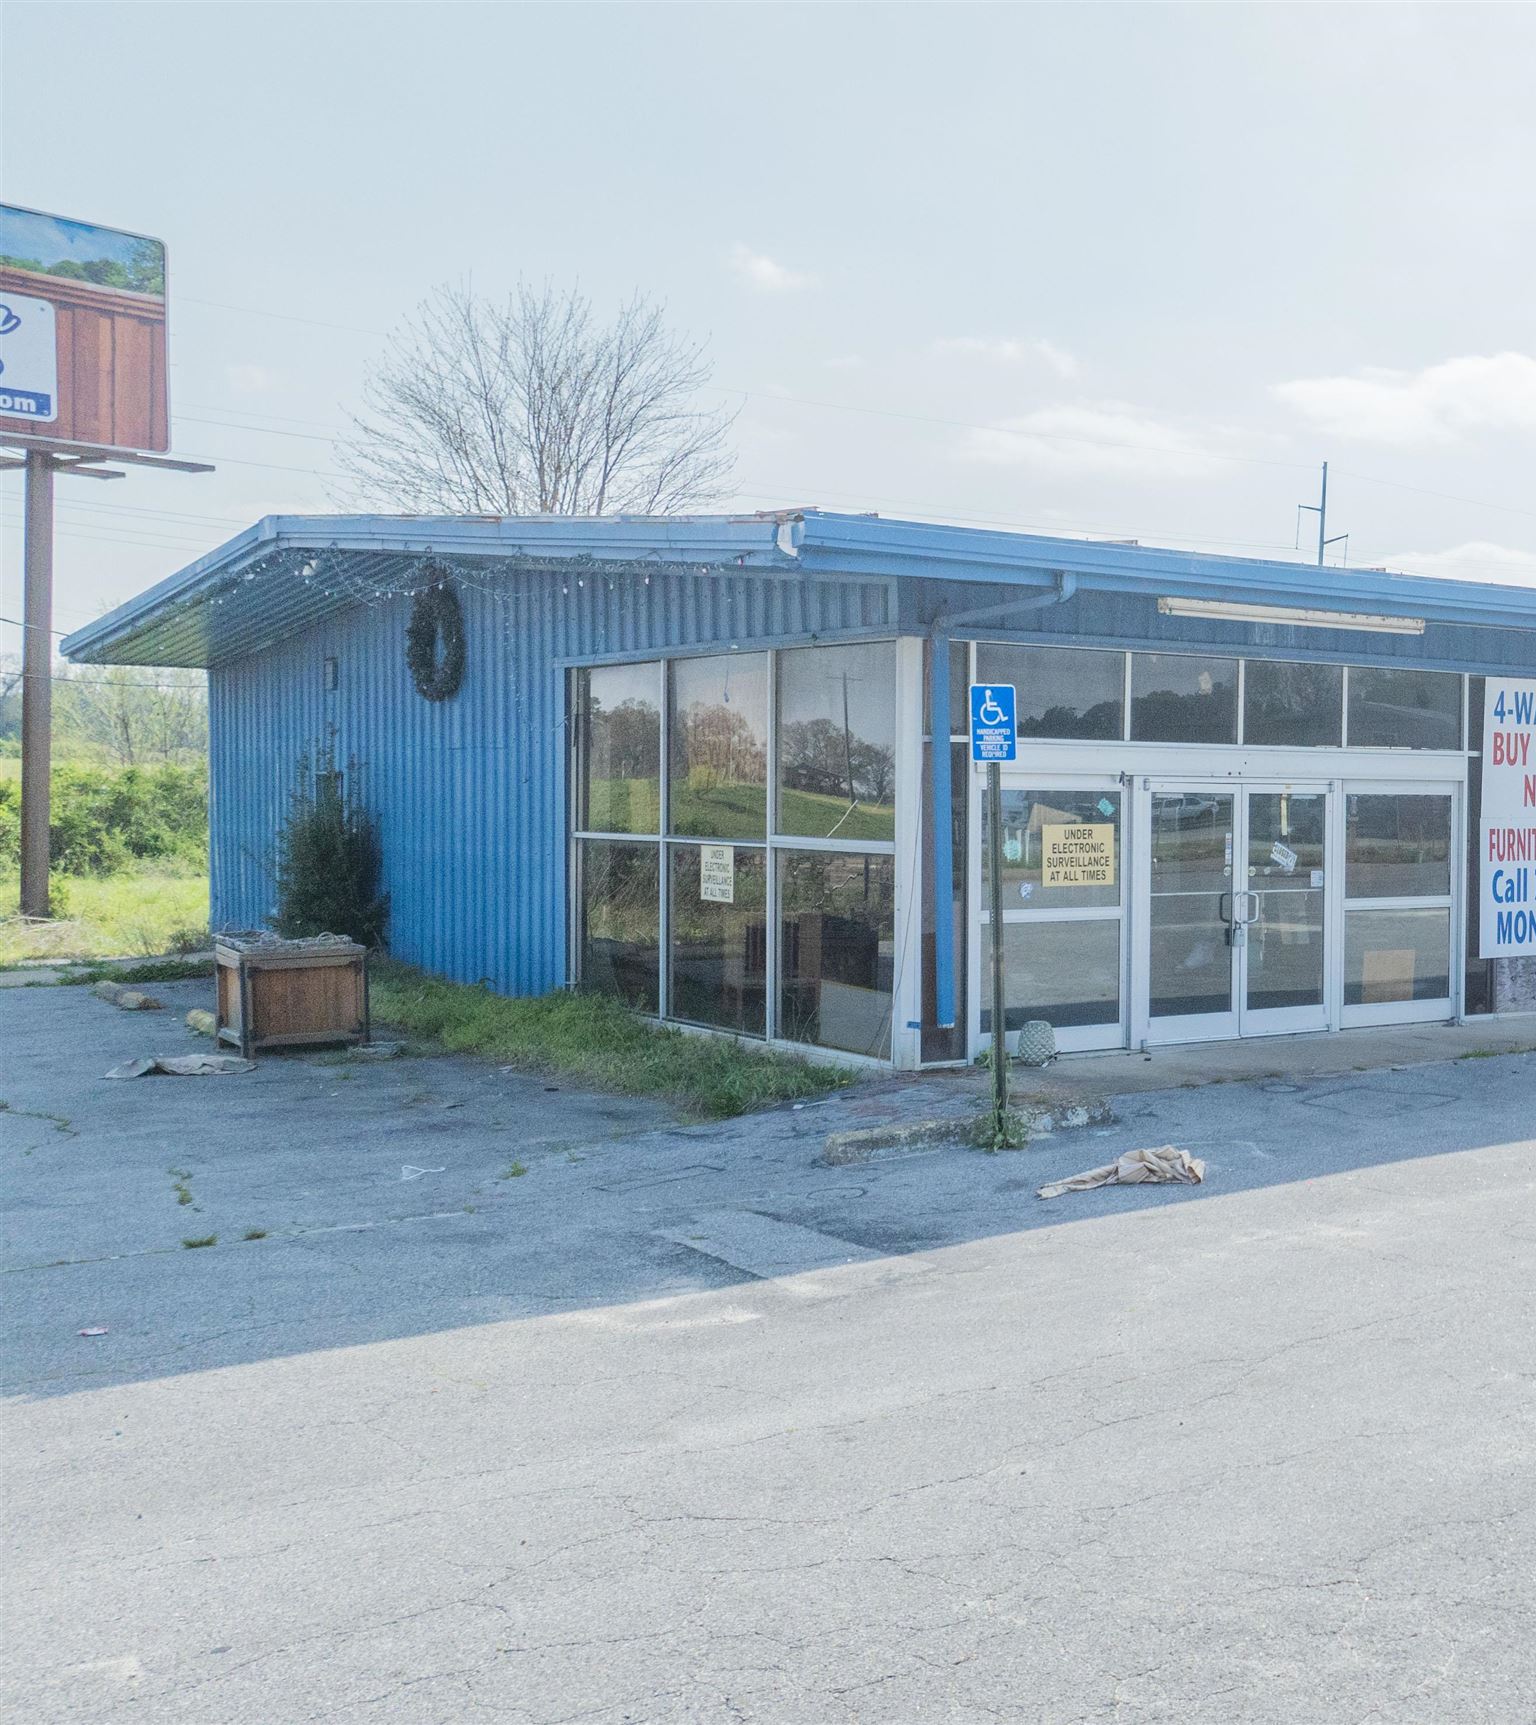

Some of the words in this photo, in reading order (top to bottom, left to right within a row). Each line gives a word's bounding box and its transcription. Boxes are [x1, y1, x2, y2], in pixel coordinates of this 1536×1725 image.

[1493, 732, 1531, 766] BUY
[1064, 829, 1093, 840] UNDER
[1052, 843, 1104, 854] ELECTRONIC
[1046, 856, 1110, 868] SURVEILLANCE
[1050, 871, 1060, 882] AT
[1063, 870, 1079, 881] ALL
[1081, 870, 1106, 881] TIMES
[1492, 869, 1527, 903] Call
